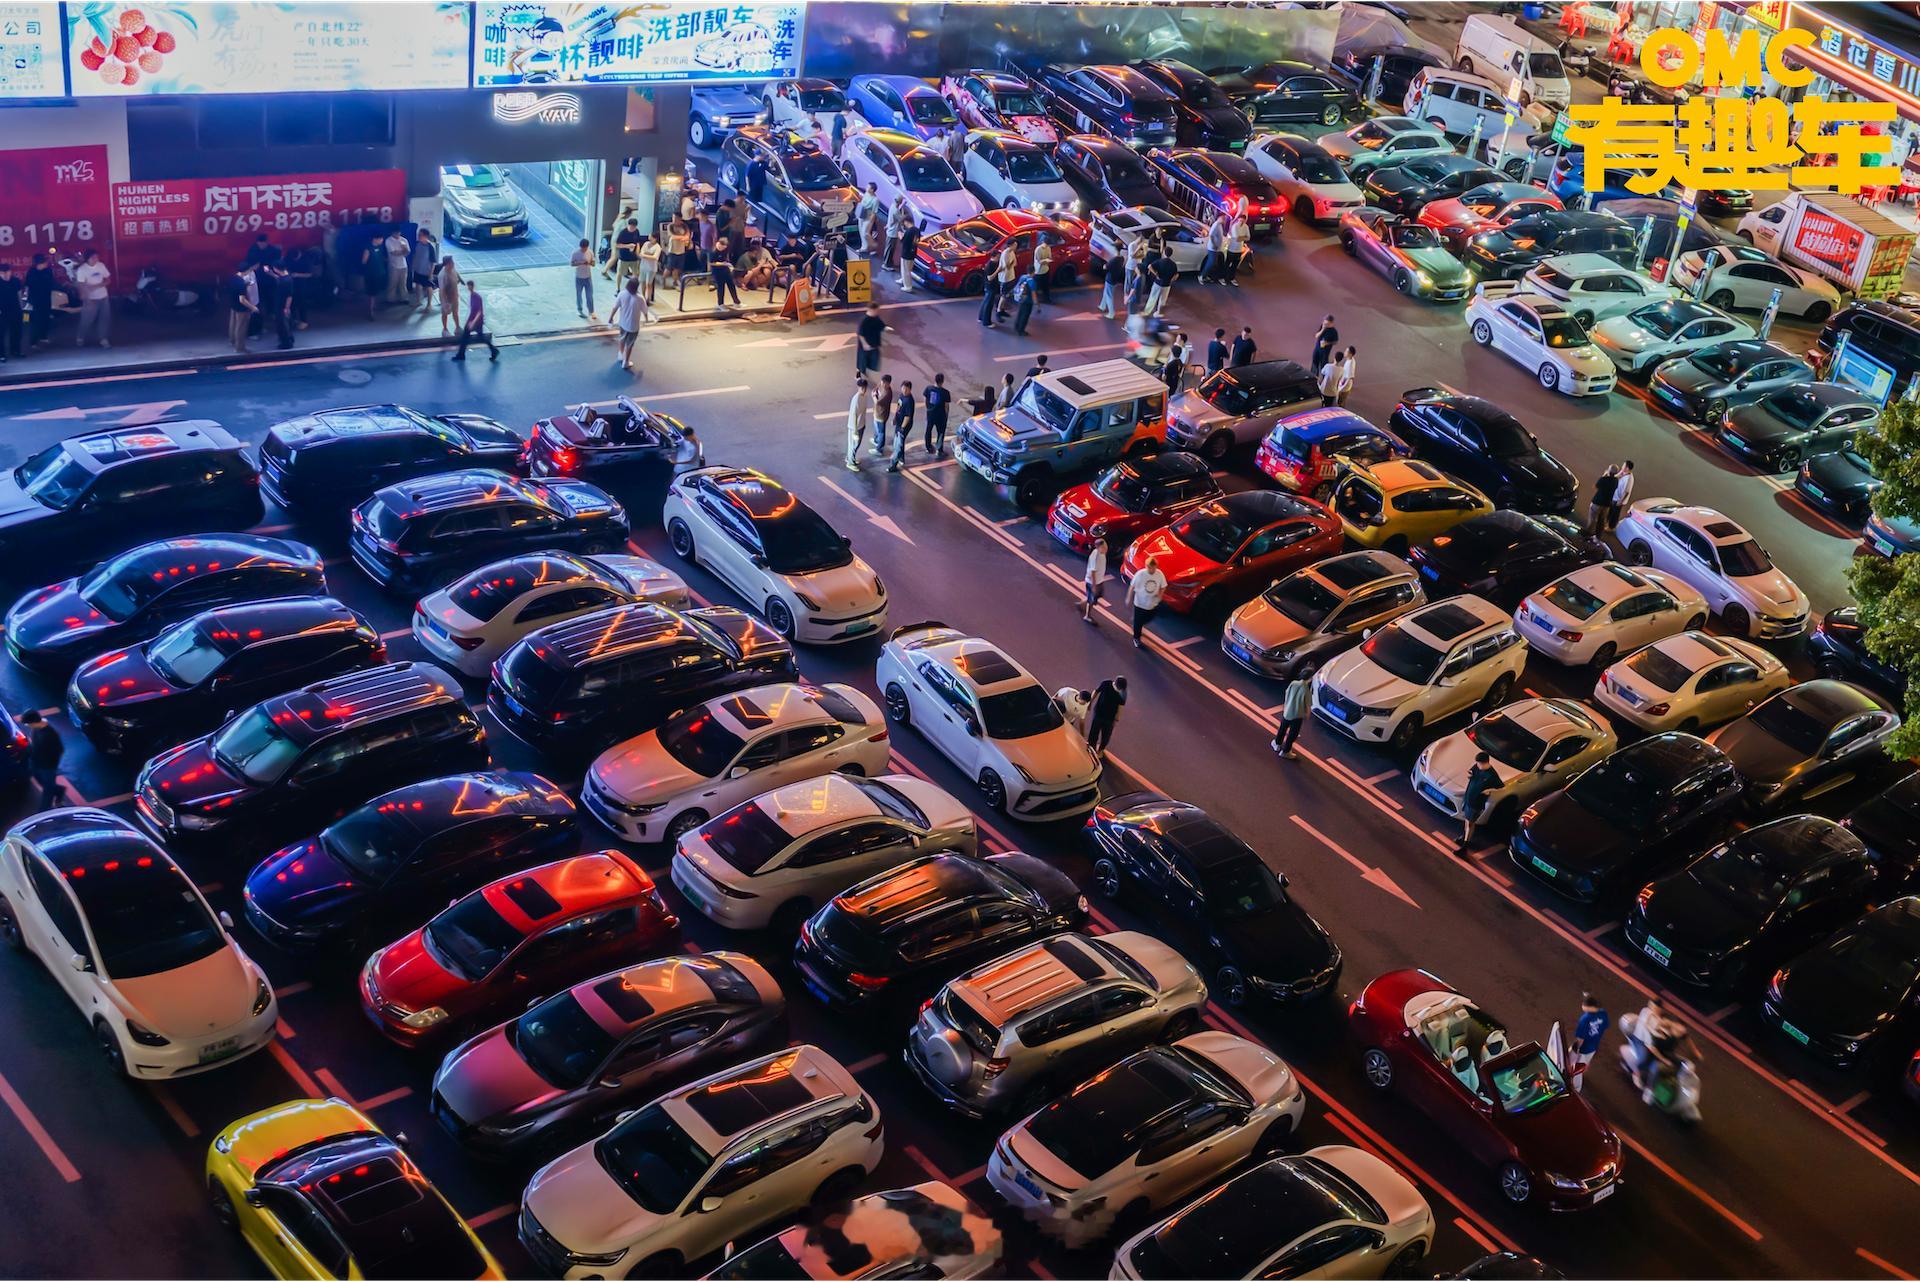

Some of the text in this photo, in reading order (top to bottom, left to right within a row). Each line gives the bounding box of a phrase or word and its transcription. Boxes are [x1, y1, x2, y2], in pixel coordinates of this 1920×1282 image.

[4, 21, 42, 36] 公司
[484, 24, 507, 68] 咖啡
[772, 19, 796, 61] 洗车
[539, 109, 580, 123] WAVE
[118, 184, 165, 196] HUMEN
[118, 193, 190, 206] NIGHTLESS
[204, 182, 333, 213] 虎门不夜天
[119, 206, 157, 216] TOWN
[24, 219, 94, 244] 1178
[123, 217, 189, 236] 招商热线
[204, 209, 332, 235] 0769-8288
